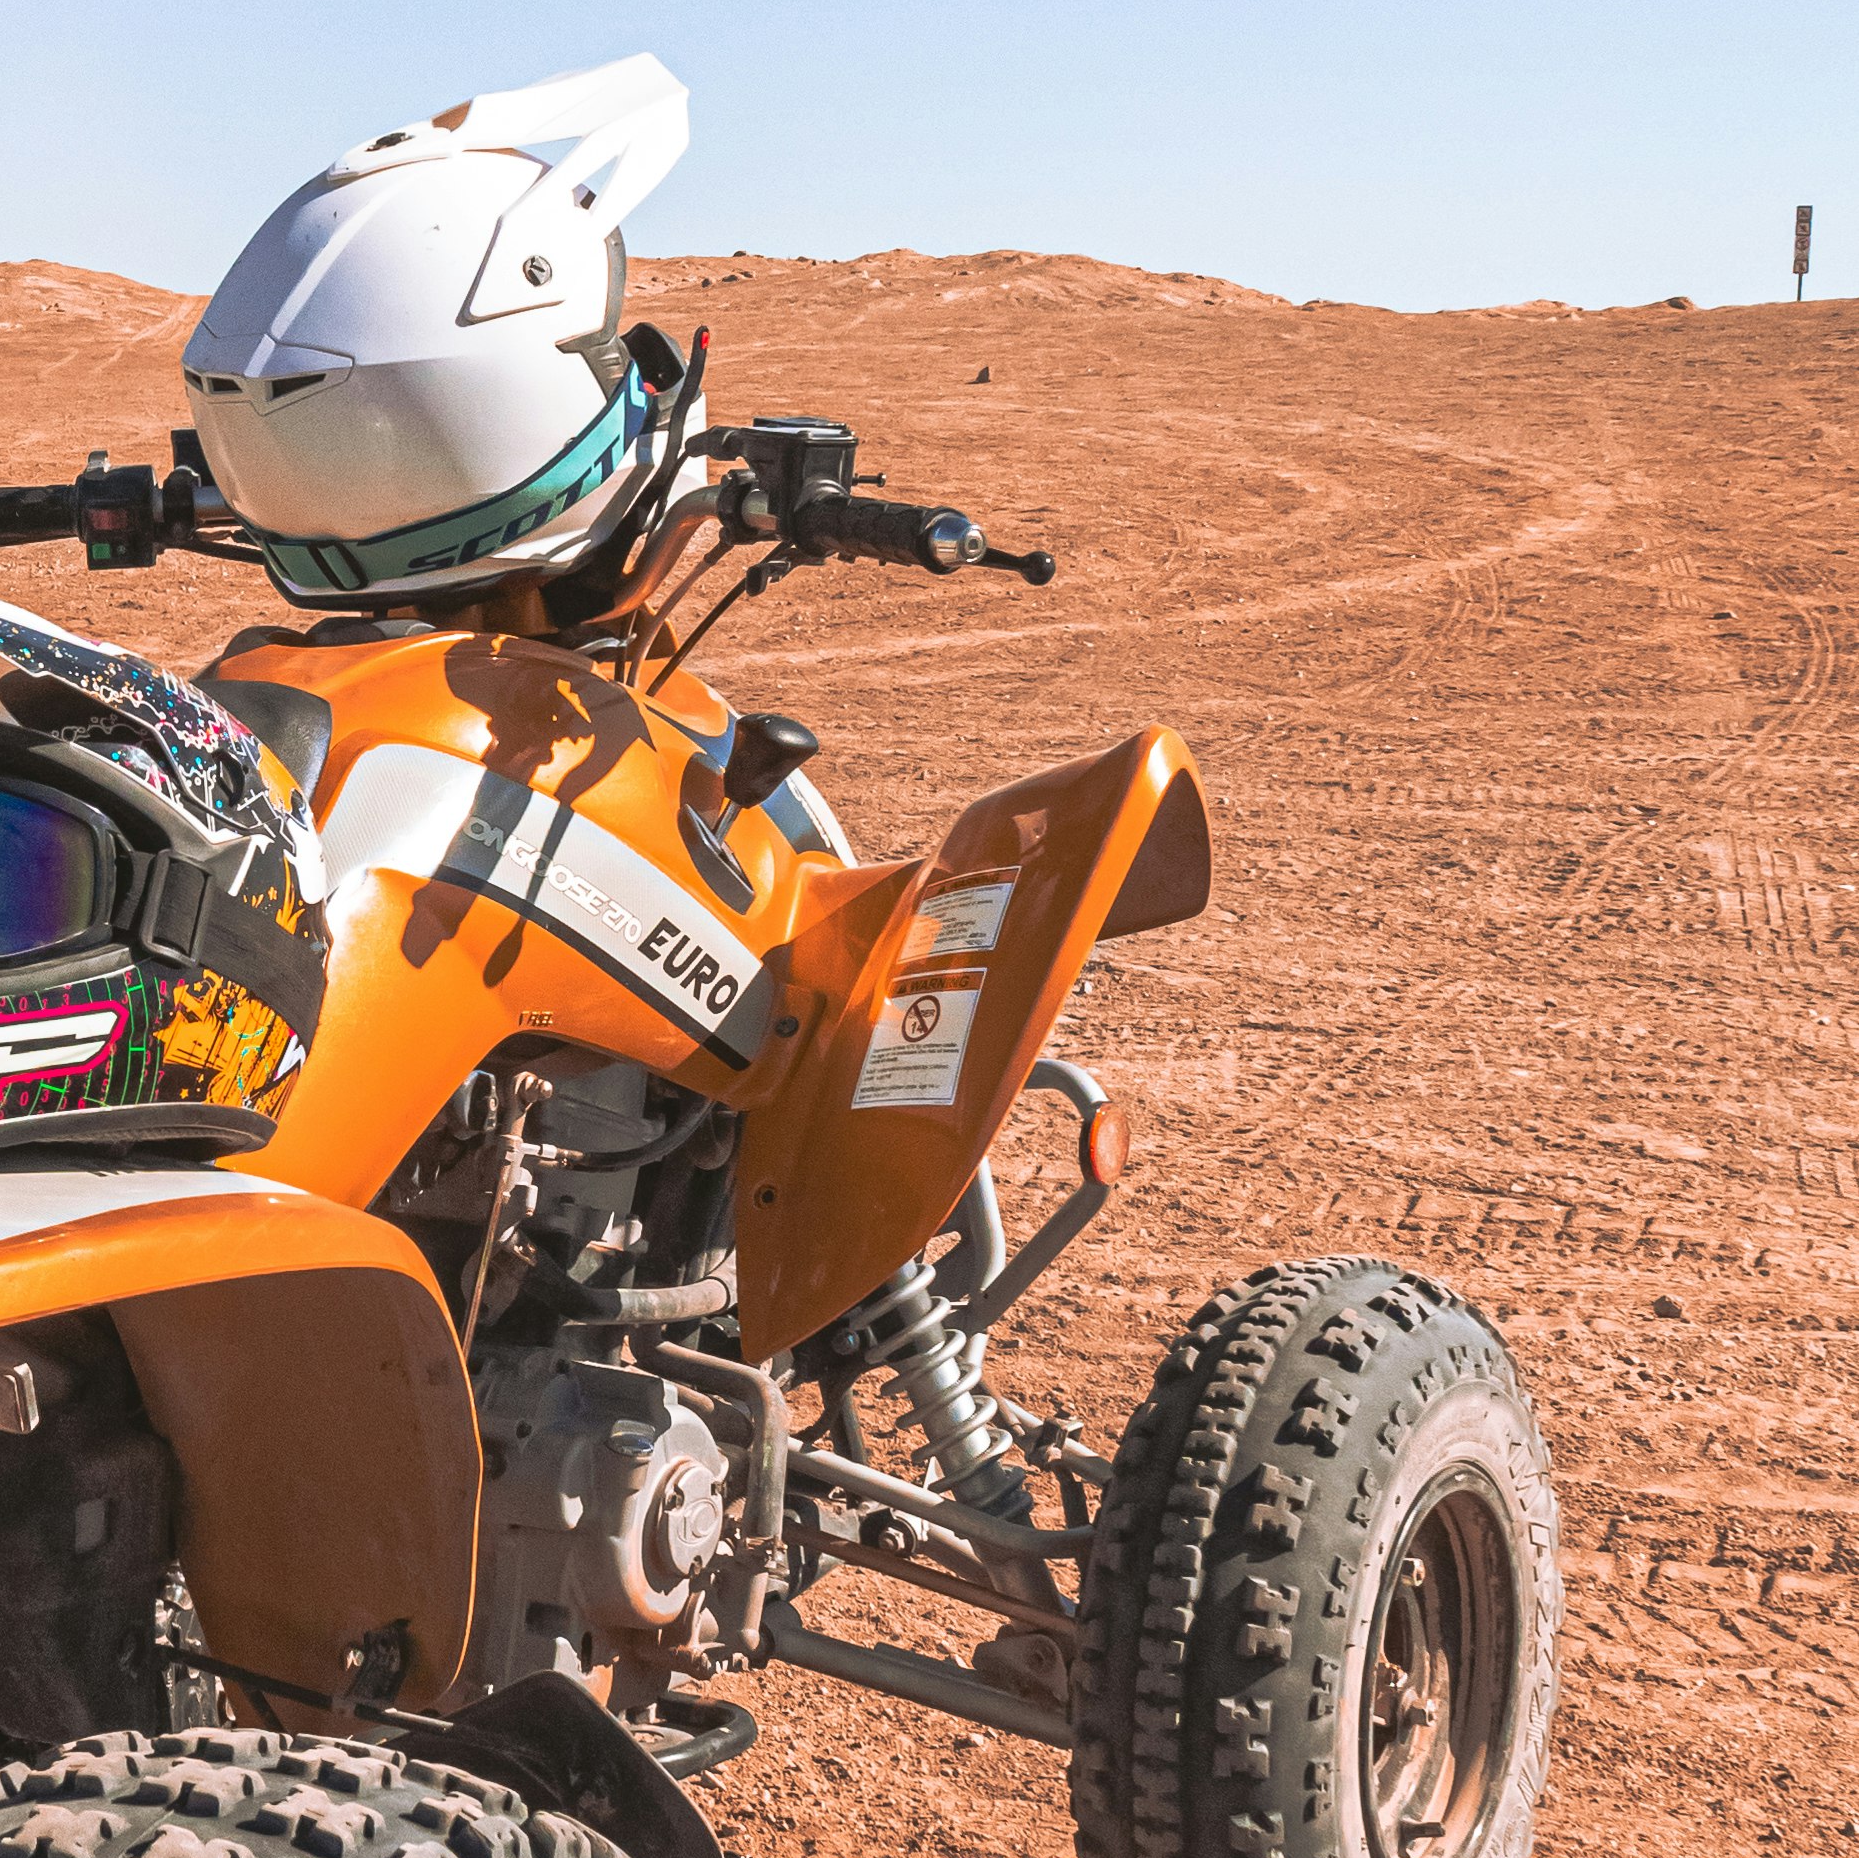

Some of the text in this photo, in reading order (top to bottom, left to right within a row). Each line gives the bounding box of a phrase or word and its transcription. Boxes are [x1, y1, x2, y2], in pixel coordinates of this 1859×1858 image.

[404, 434, 621, 576] SCOTT
[601, 901, 643, 944] 270
[637, 916, 739, 1015] EURO
[909, 975, 971, 992] WARNING
